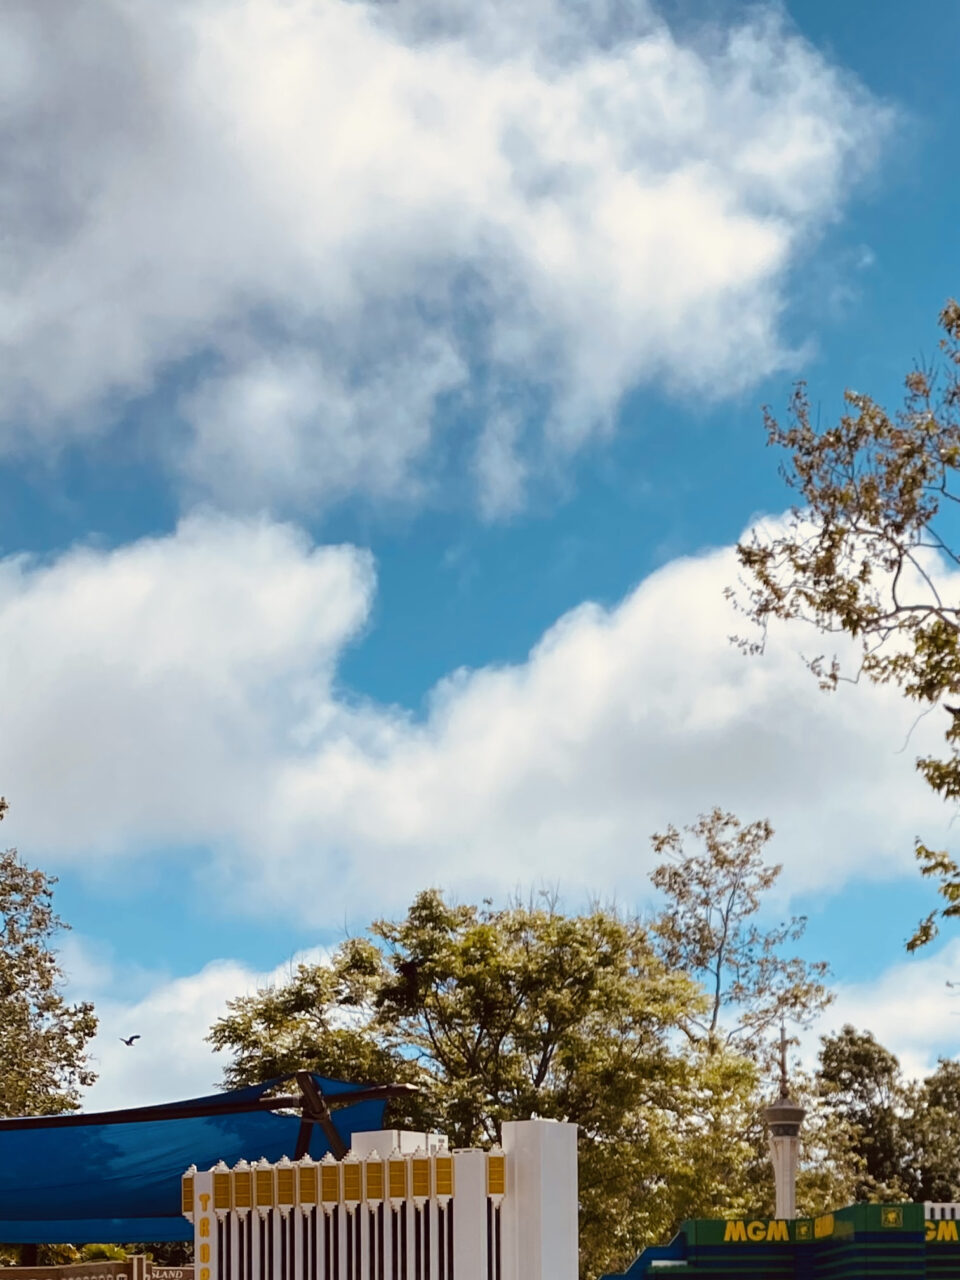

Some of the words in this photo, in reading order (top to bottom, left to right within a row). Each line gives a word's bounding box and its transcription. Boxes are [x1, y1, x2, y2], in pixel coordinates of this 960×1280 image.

[724, 1220, 790, 1242] MGM
[925, 1220, 959, 1241] GM
[151, 1270, 184, 1279] SLAND
